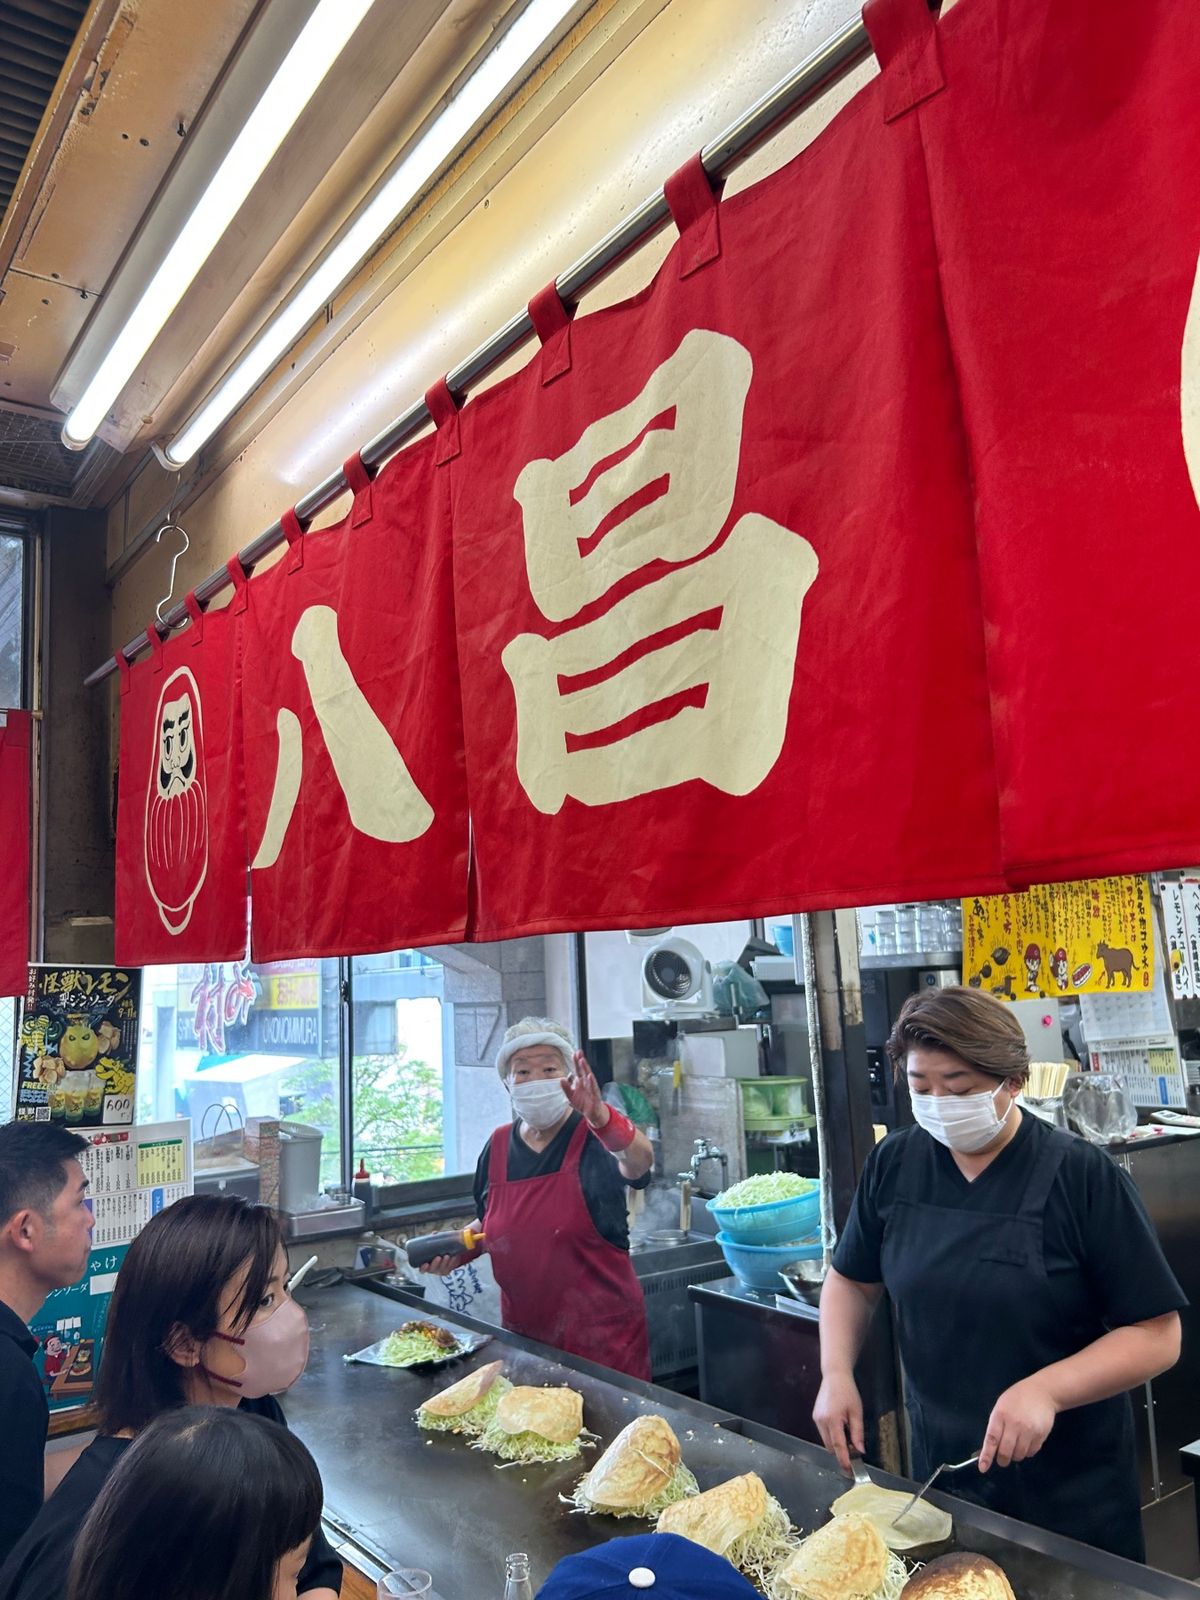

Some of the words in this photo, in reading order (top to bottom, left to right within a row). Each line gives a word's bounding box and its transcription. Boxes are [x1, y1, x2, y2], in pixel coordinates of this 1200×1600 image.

[39, 969, 132, 1001] 怪獣レモン
[106, 1099, 130, 1111] 600
